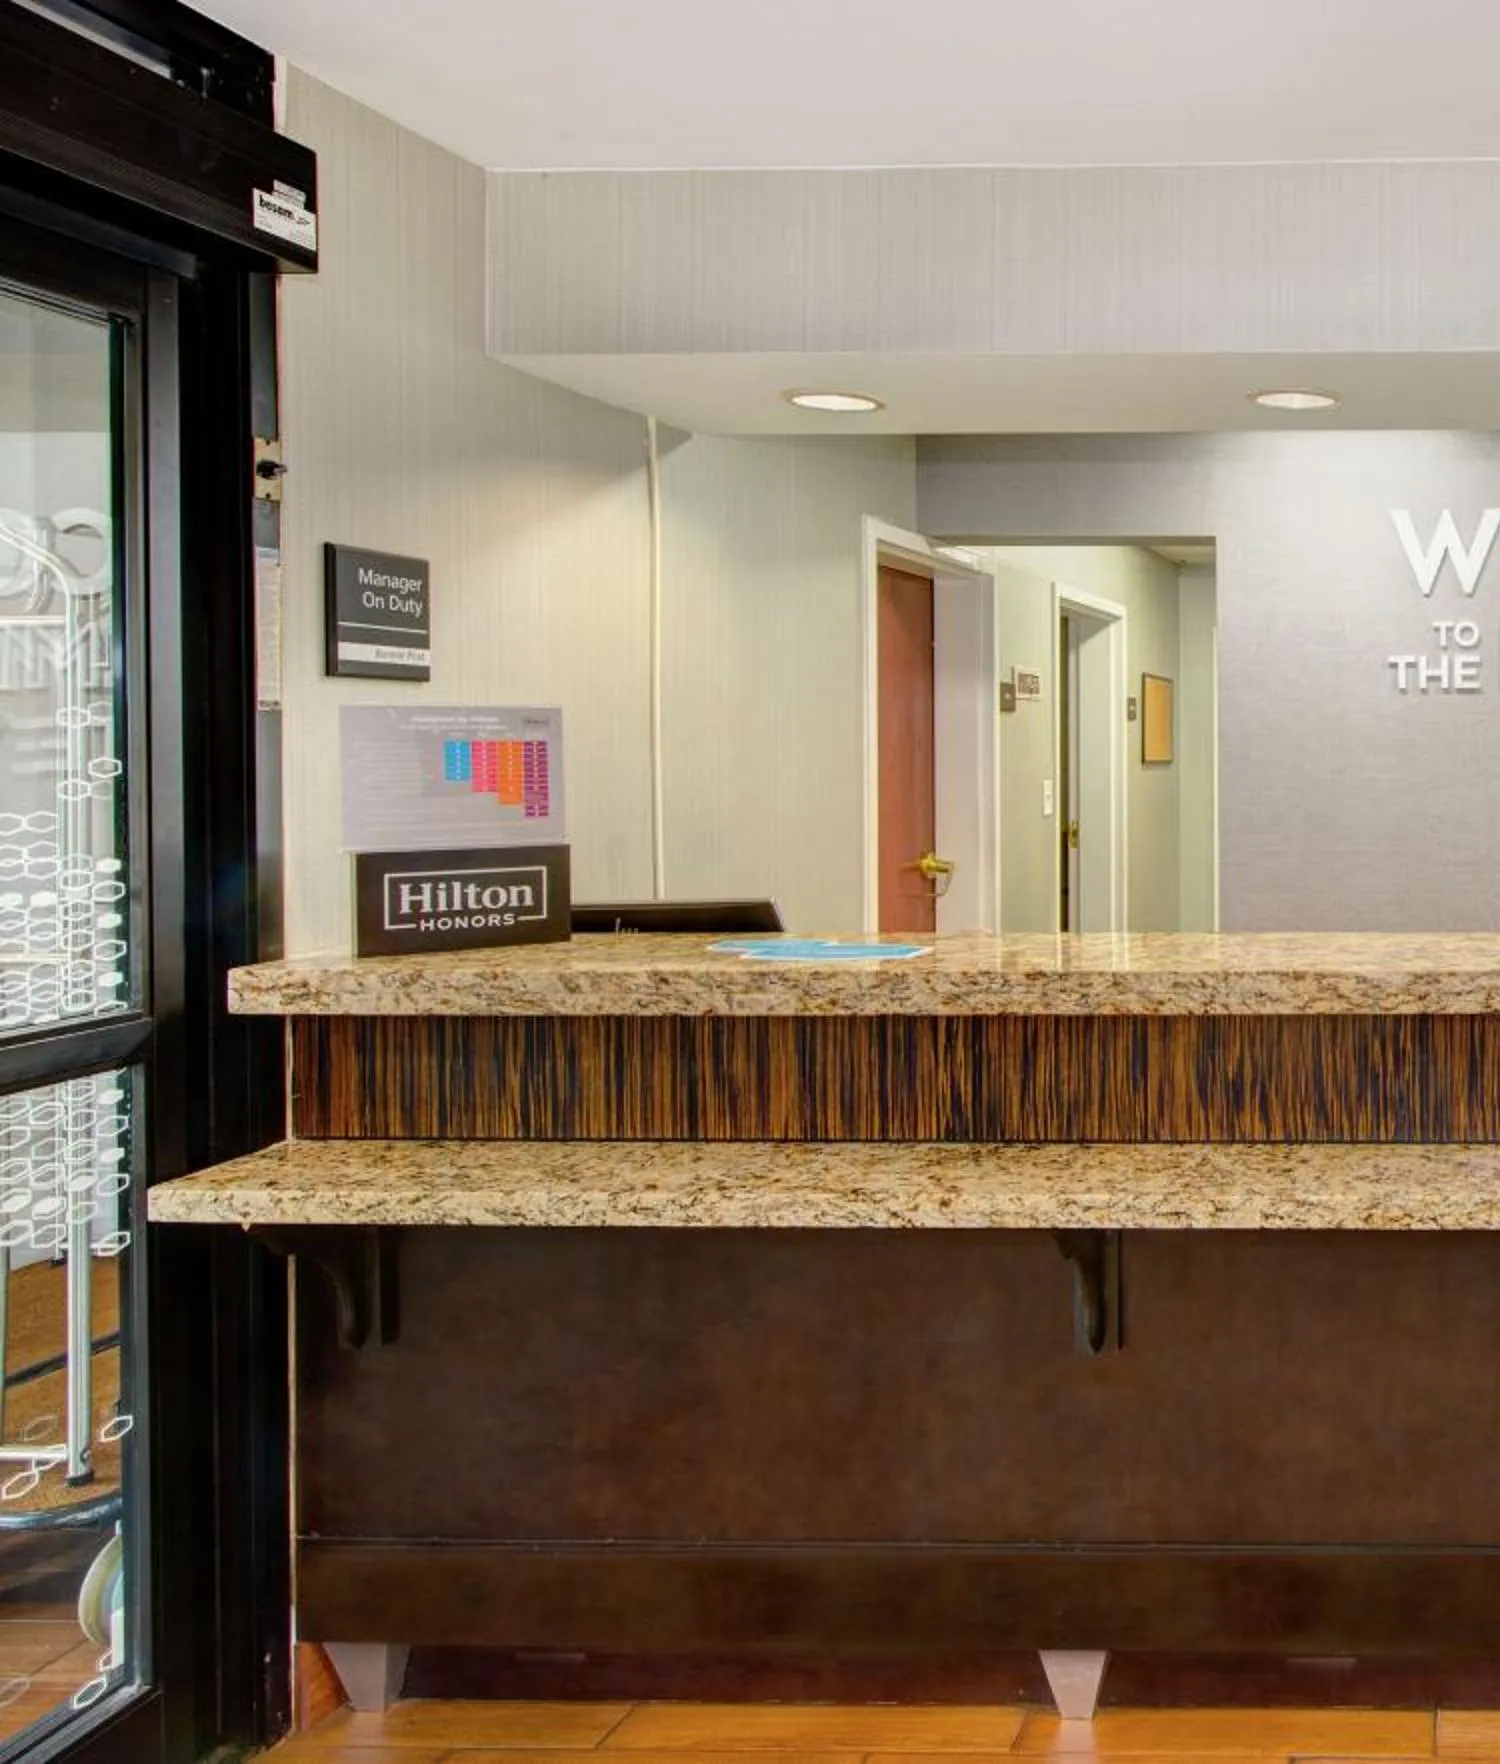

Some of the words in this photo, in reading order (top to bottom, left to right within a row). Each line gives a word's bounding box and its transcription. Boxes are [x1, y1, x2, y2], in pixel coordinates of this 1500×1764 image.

[358, 567, 422, 594] Manager
[362, 591, 385, 609] On
[389, 595, 423, 618] Duty
[1432, 621, 1480, 648] TO
[1388, 654, 1482, 691] THE
[399, 881, 534, 914] Hilton
[420, 913, 516, 932] HONORS
